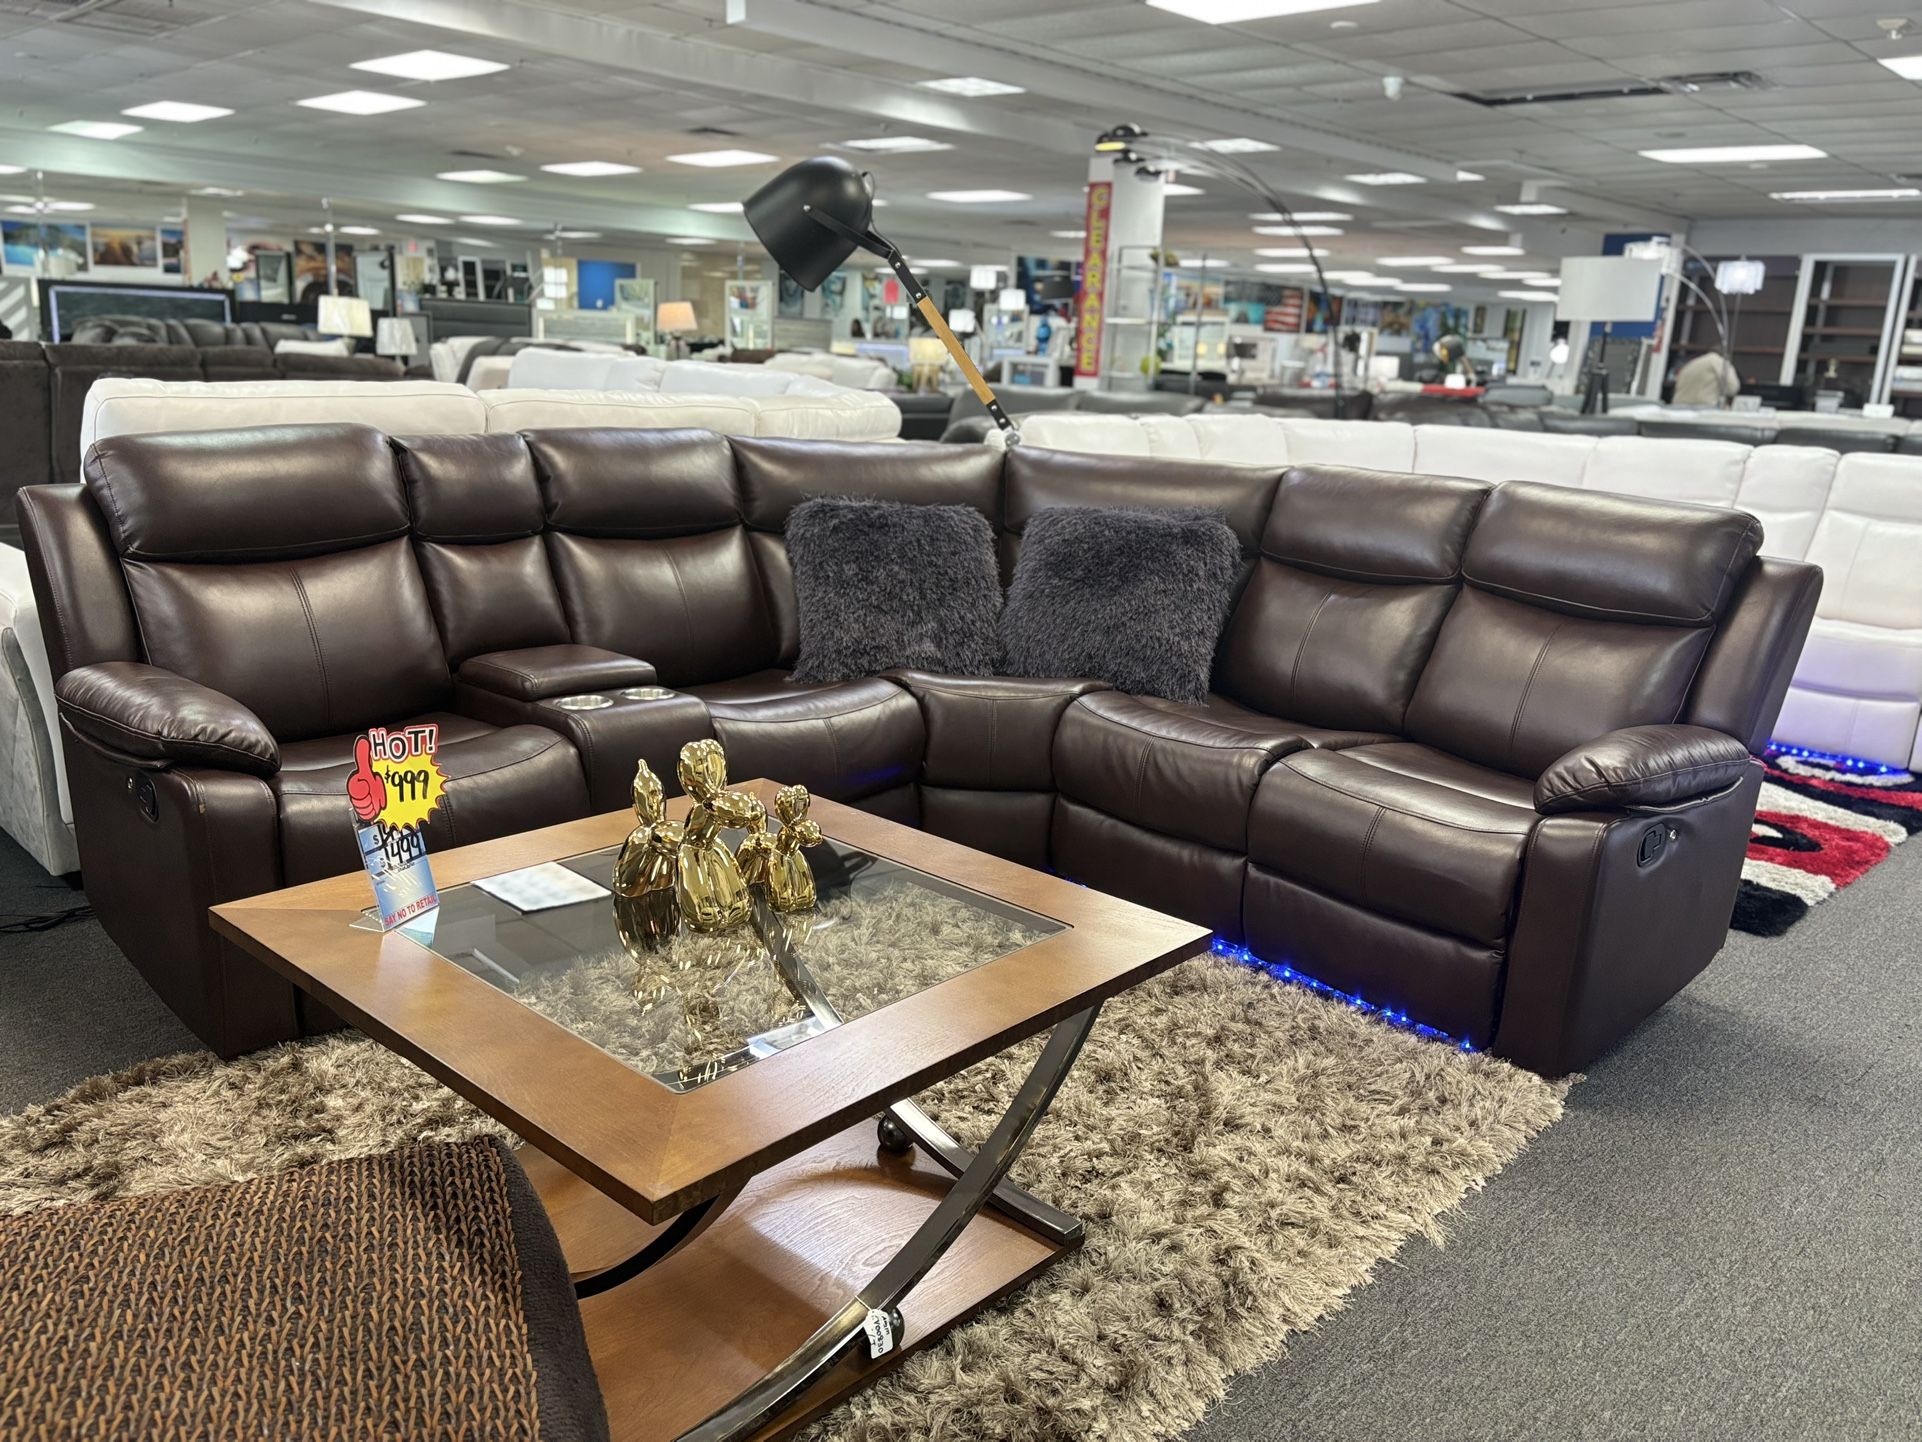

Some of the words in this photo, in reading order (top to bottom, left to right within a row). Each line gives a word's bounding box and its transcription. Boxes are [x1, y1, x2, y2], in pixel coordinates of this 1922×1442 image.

[1081, 186, 1109, 371] CLEARANCE
[371, 727, 435, 761] HOT!
[384, 765, 429, 802] $999
[384, 912, 397, 926] SAY
[397, 909, 407, 920] NO
[407, 904, 416, 915] TO
